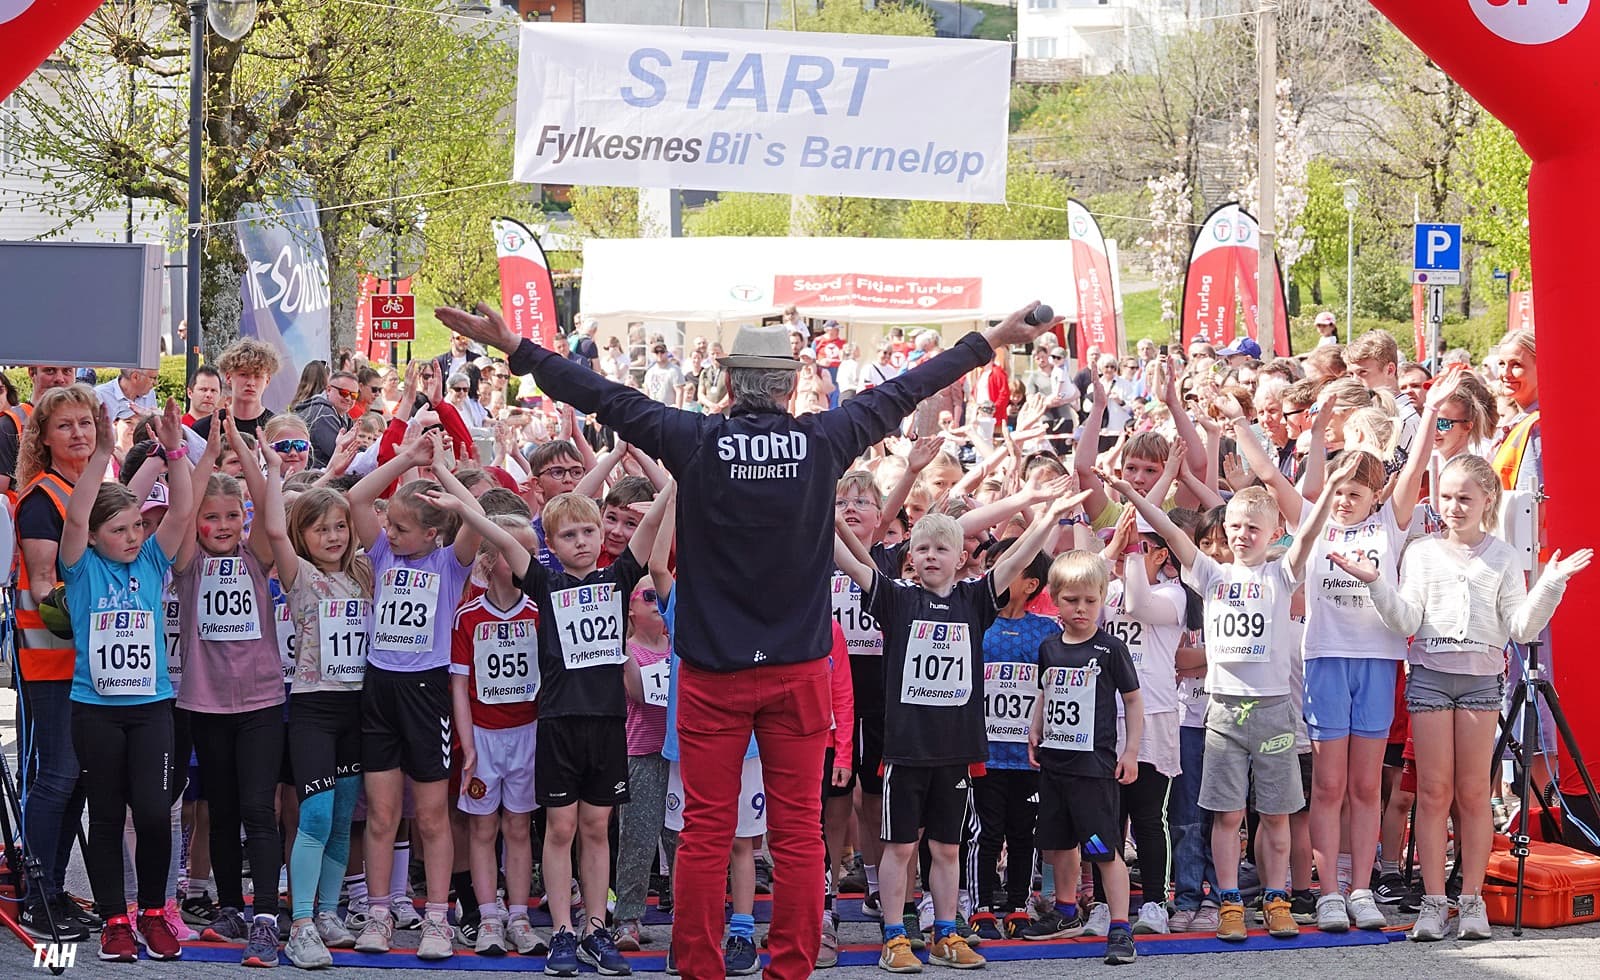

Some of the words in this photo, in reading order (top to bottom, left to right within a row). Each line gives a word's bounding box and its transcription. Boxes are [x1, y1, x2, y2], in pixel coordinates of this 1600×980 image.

[620, 48, 890, 117] START
[800, 136, 985, 183] Barneløp
[1427, 230, 1452, 264] P
[793, 277, 842, 291] Stord
[857, 278, 904, 293] Fitjar
[906, 281, 964, 295] Turlag
[1197, 275, 1213, 320] Turlag
[374, 331, 409, 339] Haugesund
[1214, 306, 1225, 339] Turlag
[718, 431, 807, 461] STORD
[730, 463, 799, 479] FRIIDRETT
[203, 590, 252, 616] 1036
[380, 600, 428, 628] 1123
[581, 604, 599, 612] 2024
[115, 630, 134, 638] 2024
[565, 615, 619, 645] 1022
[1213, 612, 1265, 638] 1039
[97, 643, 151, 670] 1055
[932, 642, 950, 650] 2024
[487, 652, 529, 679] 955
[912, 653, 964, 681] 1071
[999, 681, 1017, 689] 2024
[984, 693, 1036, 719] 1037
[1047, 699, 1080, 727] 953
[751, 792, 765, 820] 9
